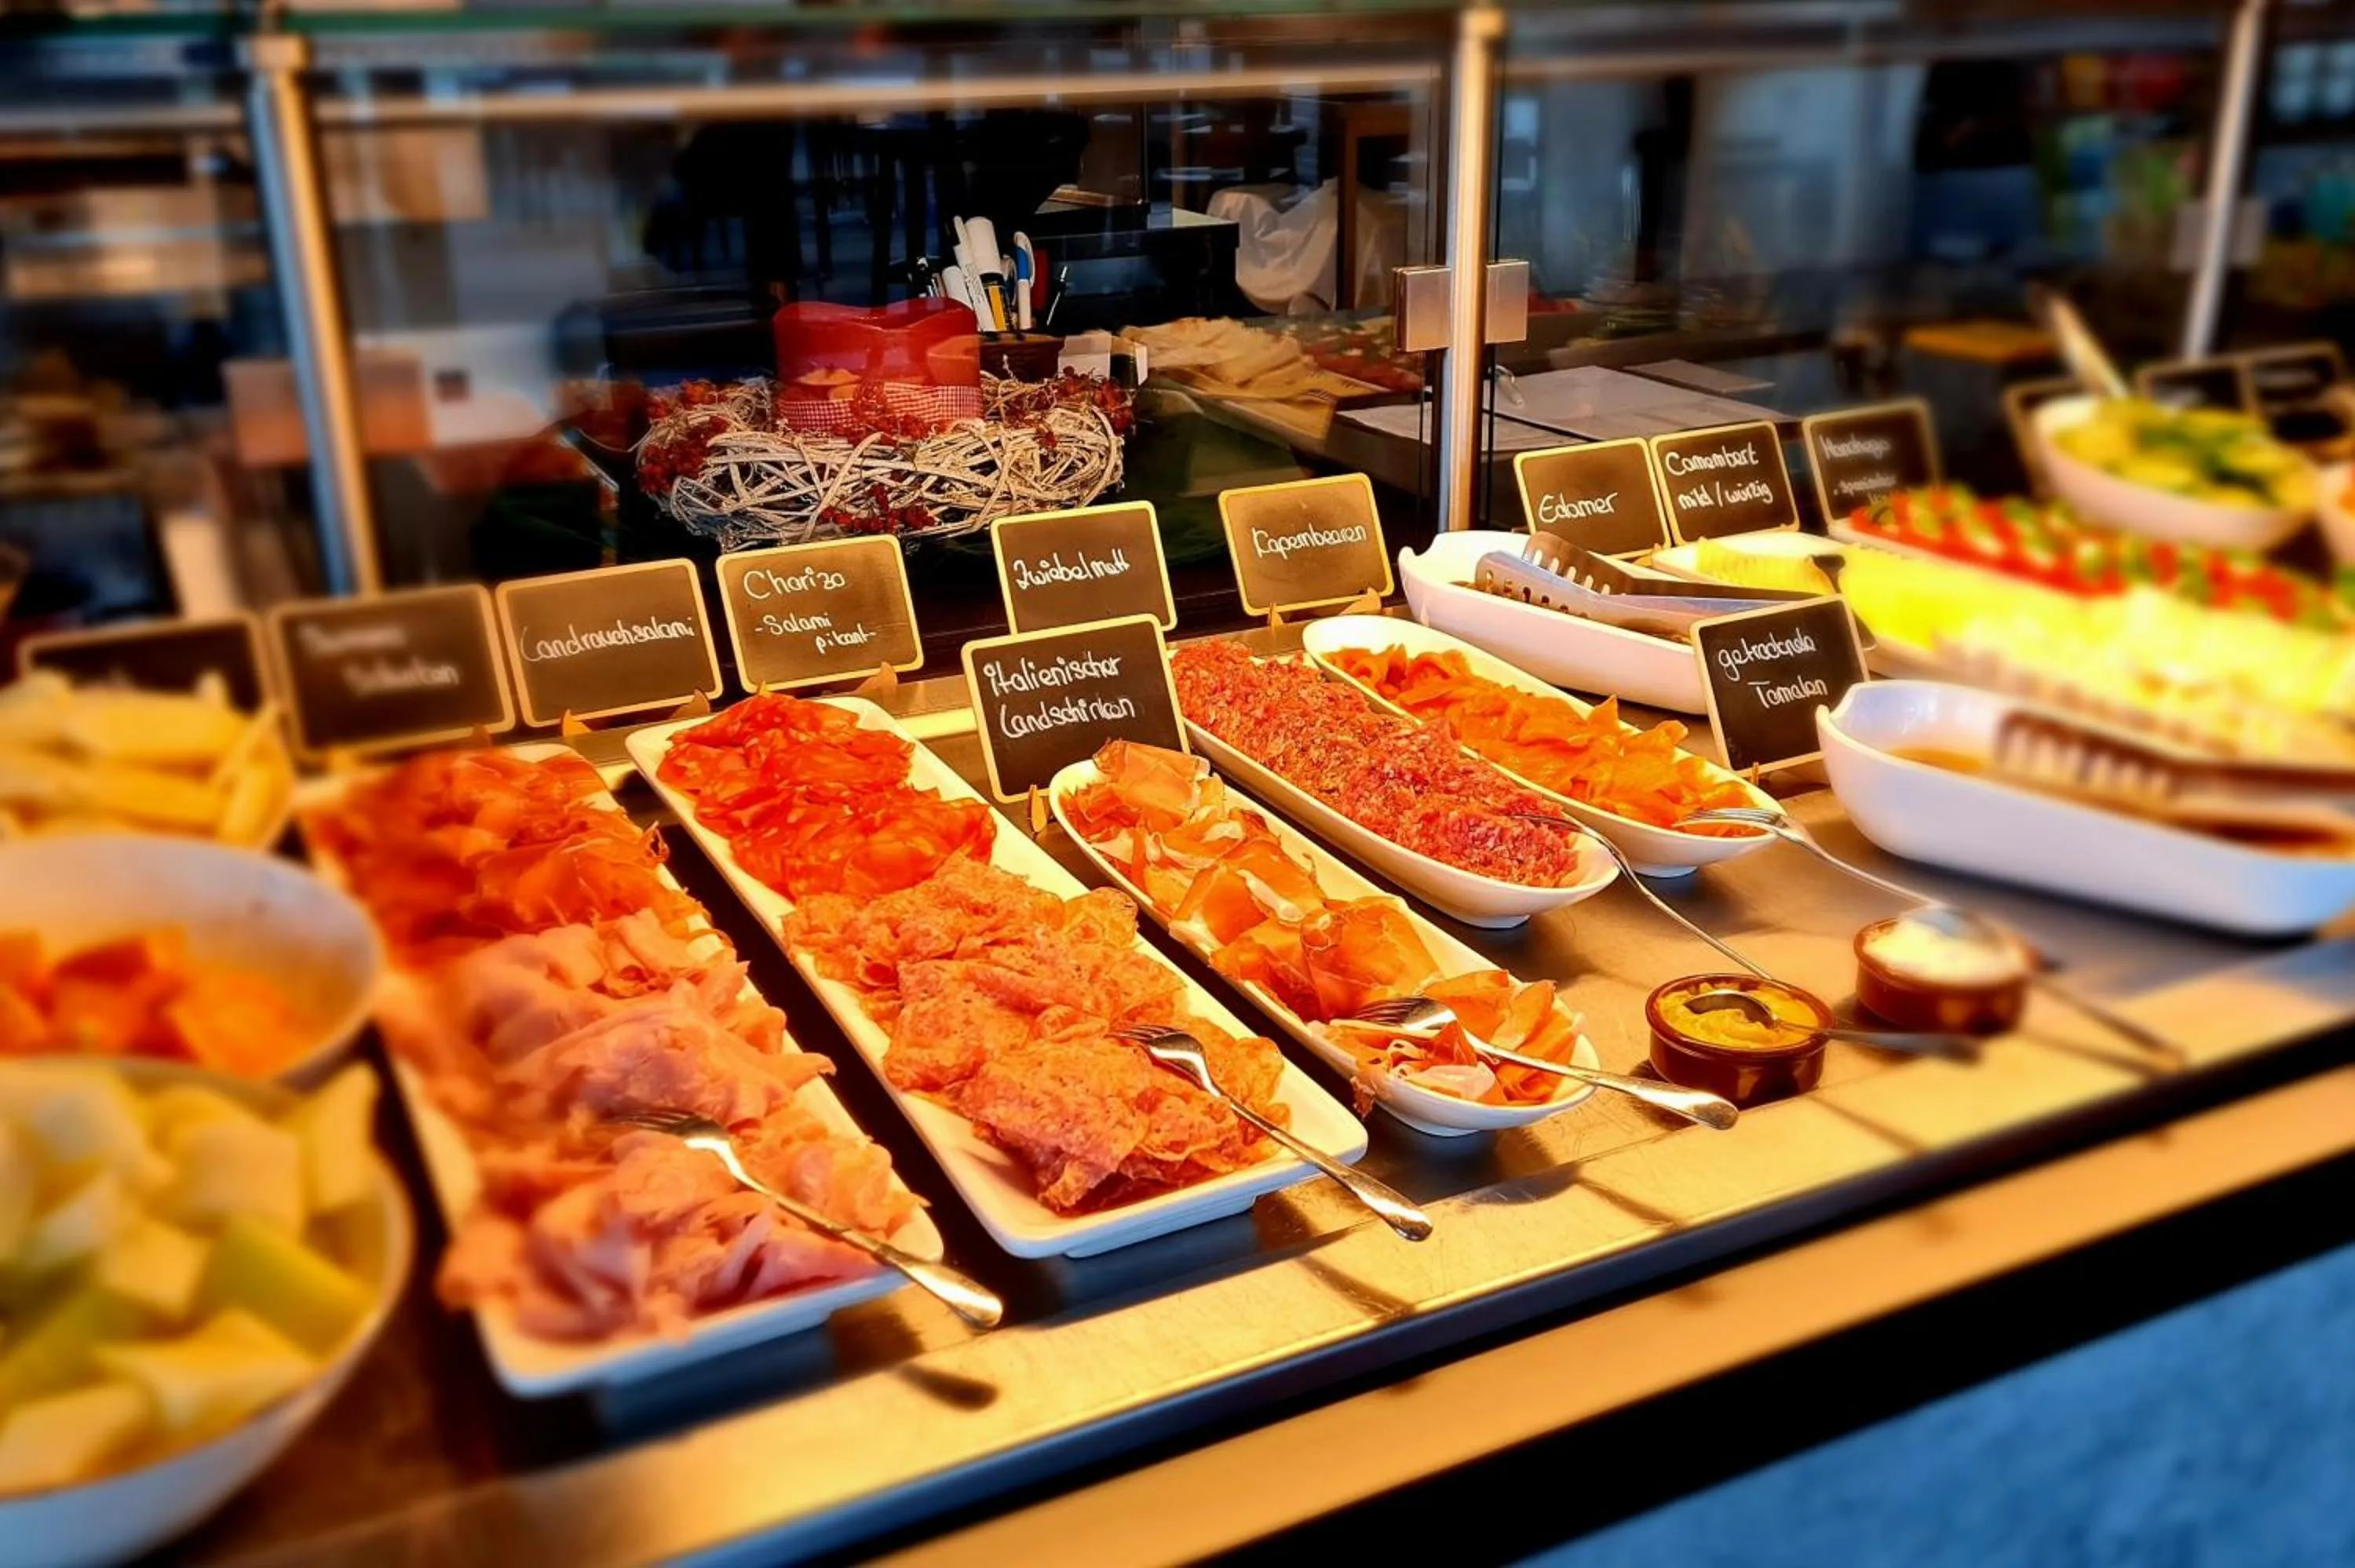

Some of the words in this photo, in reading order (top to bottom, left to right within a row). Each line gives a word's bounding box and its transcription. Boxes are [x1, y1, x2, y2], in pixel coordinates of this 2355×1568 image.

[1665, 440, 1759, 476] Camembert
[1538, 492, 1619, 523] Edamer
[1678, 483, 1714, 509] mild
